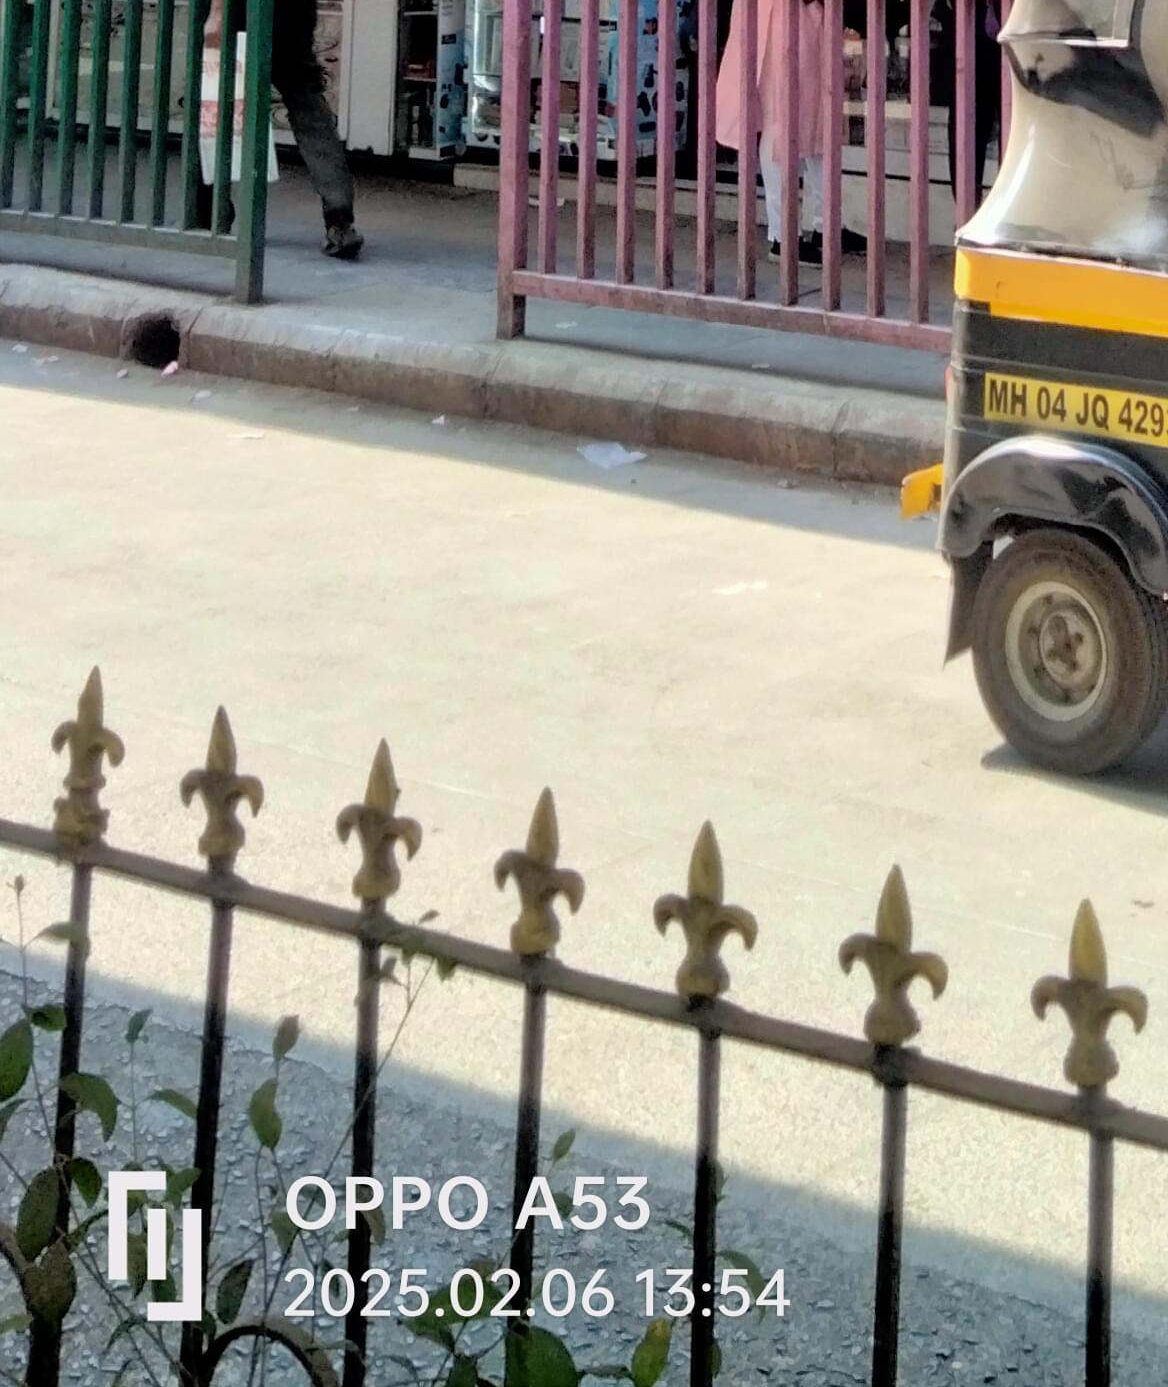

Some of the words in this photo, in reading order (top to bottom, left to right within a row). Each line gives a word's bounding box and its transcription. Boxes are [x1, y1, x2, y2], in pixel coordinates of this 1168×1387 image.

[988, 378, 1028, 419] MH
[1036, 385, 1067, 422] 04
[1075, 392, 1110, 431] JQ
